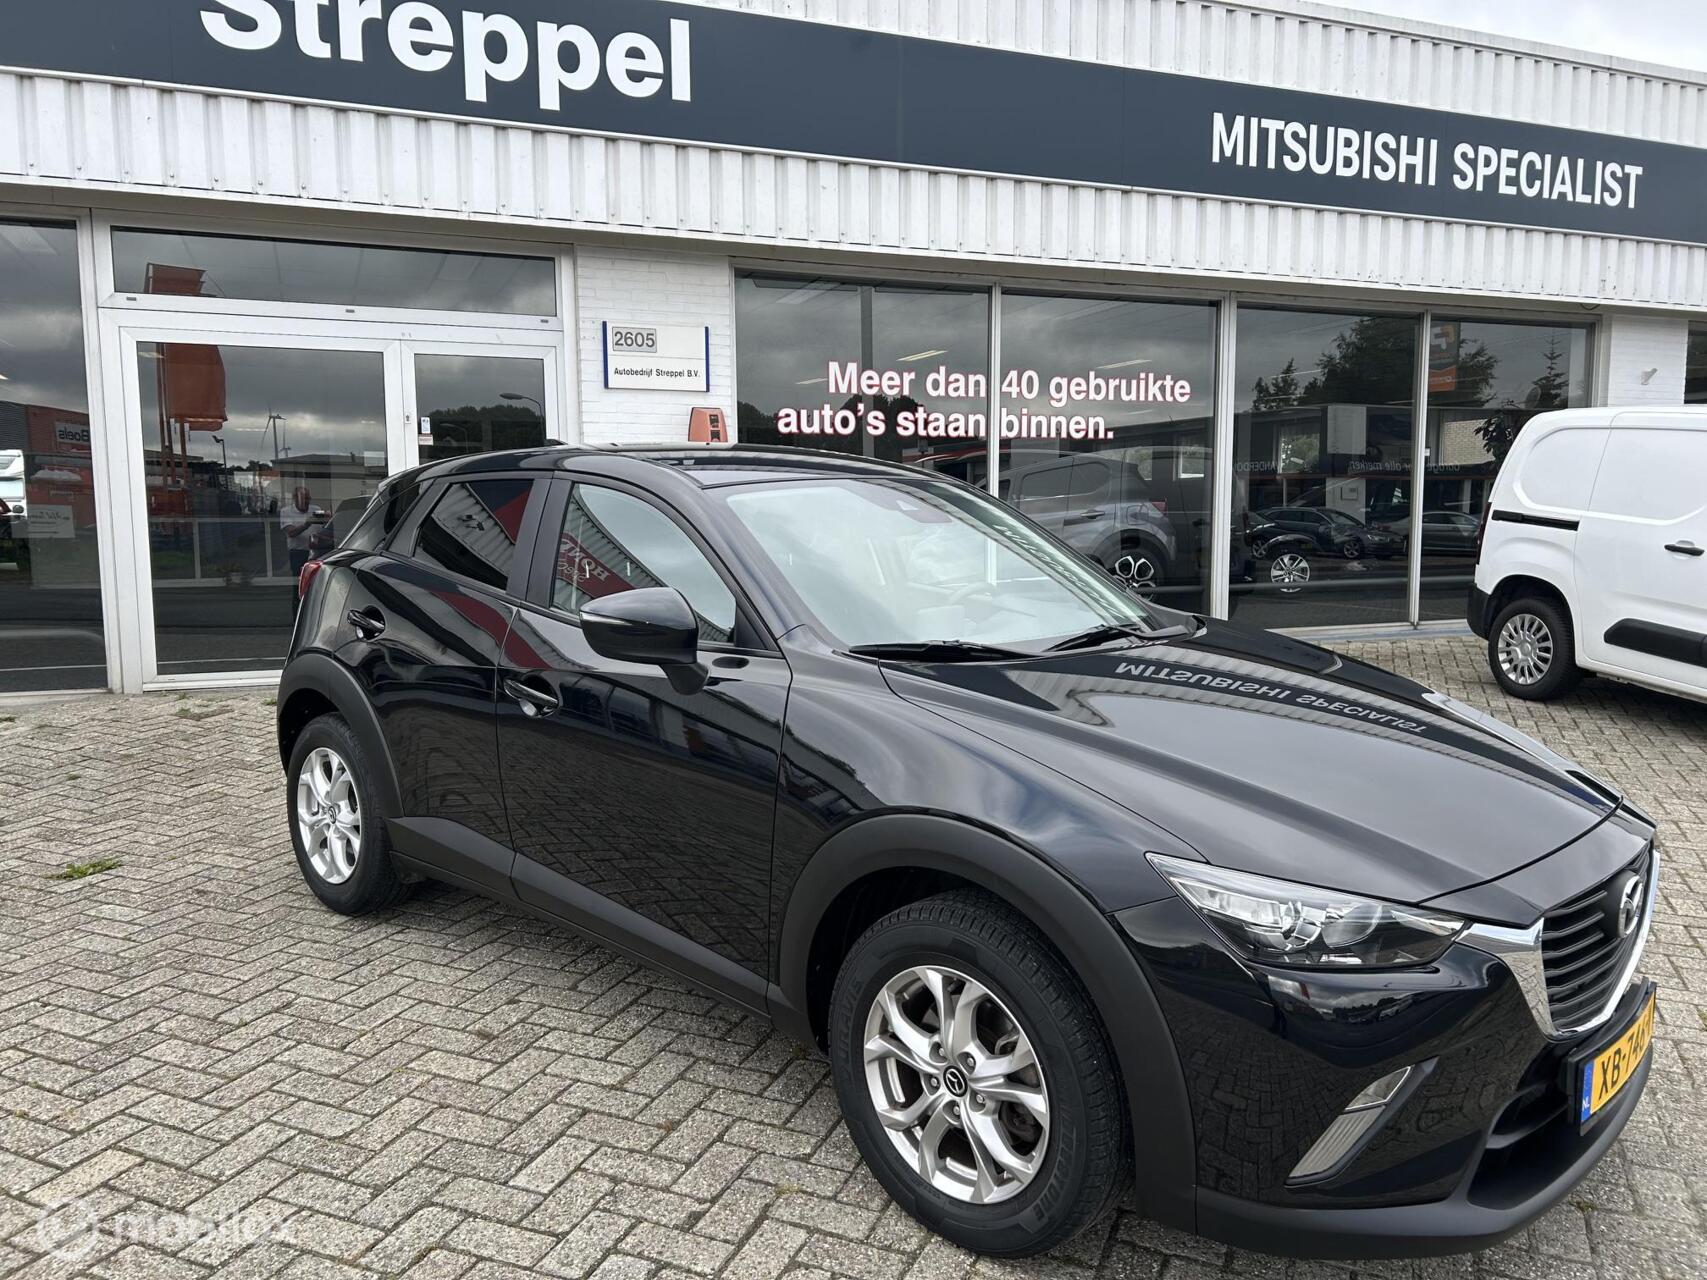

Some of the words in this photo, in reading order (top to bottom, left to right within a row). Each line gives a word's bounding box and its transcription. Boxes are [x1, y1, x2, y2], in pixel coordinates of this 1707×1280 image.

[200, 0, 692, 111] Streppel
[1212, 112, 1438, 186] MITSUBISHI
[1453, 143, 1644, 209] SPECIALIST
[614, 331, 655, 348] 2605
[614, 367, 653, 378] Autobedrijf
[655, 368, 685, 378] Streppel
[687, 369, 701, 378] B.V.
[828, 361, 915, 397] Meer
[925, 366, 986, 398] dan
[1001, 370, 1040, 399] 40
[1049, 371, 1191, 408] gebruikte
[777, 402, 886, 435] auto's
[896, 408, 986, 437] staan
[1000, 407, 1115, 439] binnen.
